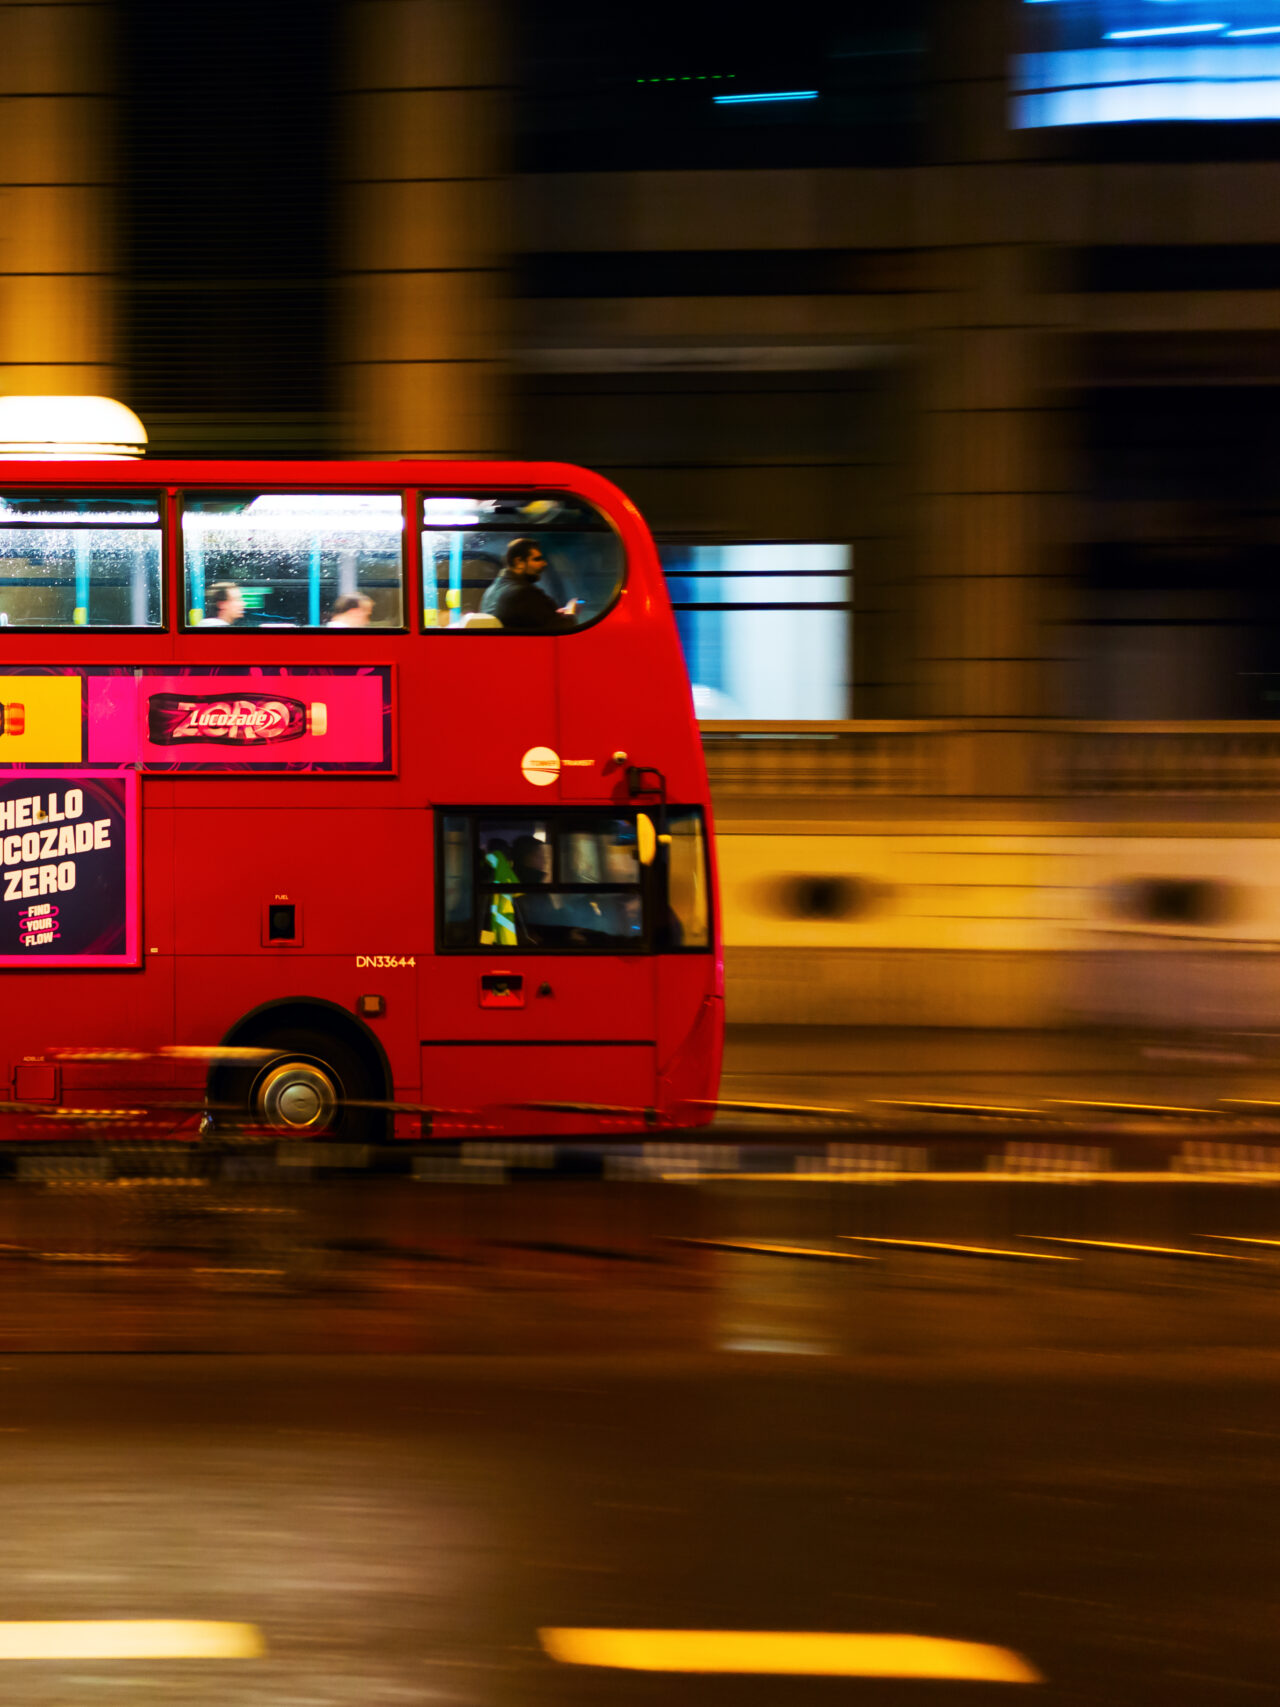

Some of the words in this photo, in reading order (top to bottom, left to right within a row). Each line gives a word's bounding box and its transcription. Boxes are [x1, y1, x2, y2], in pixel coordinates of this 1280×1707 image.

[190, 710, 268, 726] Lucozade
[3, 861, 76, 902] ZERO
[28, 903, 51, 917] FIND
[26, 918, 53, 932] YOUR
[25, 932, 53, 947] FLOW
[356, 955, 416, 968] DN33644
